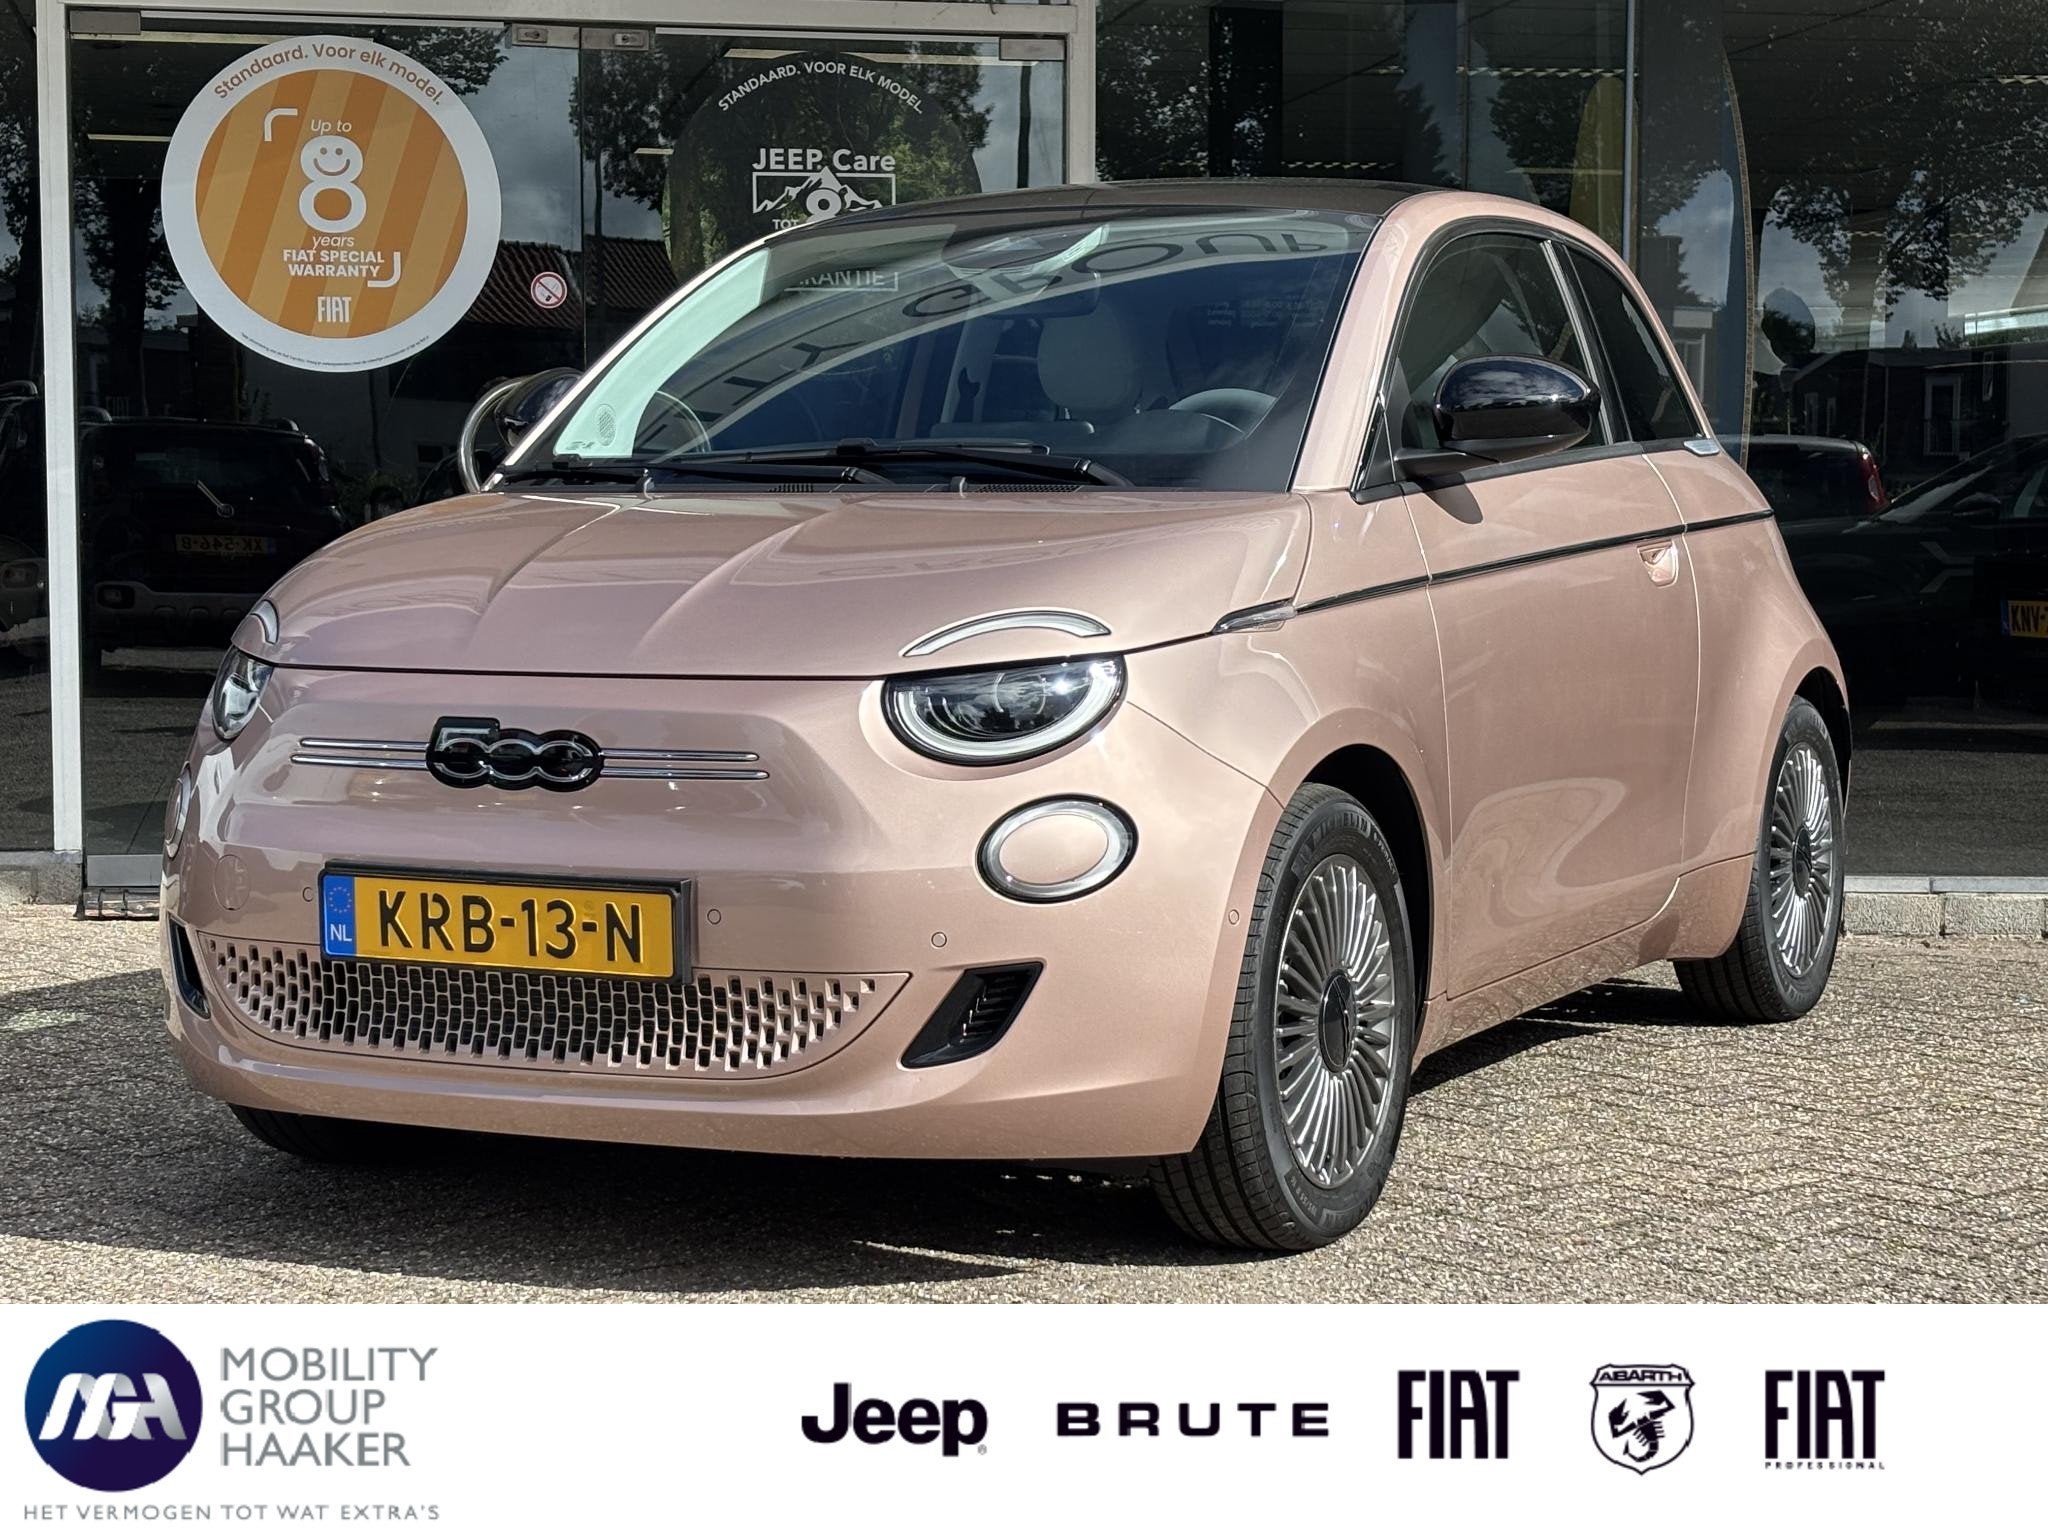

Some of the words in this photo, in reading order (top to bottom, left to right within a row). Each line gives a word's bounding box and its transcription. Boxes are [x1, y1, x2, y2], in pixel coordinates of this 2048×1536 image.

[214, 44, 309, 99] Standaard.
[312, 43, 356, 58] Voor
[359, 51, 386, 69] elk
[388, 60, 444, 106] model.
[803, 61, 846, 75] VOOR
[849, 65, 875, 84] ELK
[876, 74, 923, 115] MODEL
[310, 119, 332, 135] Up
[336, 119, 352, 133] to
[832, 148, 897, 171] Care
[299, 135, 367, 233] 8
[311, 235, 355, 250] years
[282, 249, 316, 262] FIAT
[319, 250, 385, 264] SPECIAL
[287, 264, 380, 278] WARRANTY
[316, 296, 352, 324] FIAT
[426, 716, 605, 793] 500
[330, 923, 353, 942] NL
[378, 889, 643, 963] KRB-13-N
